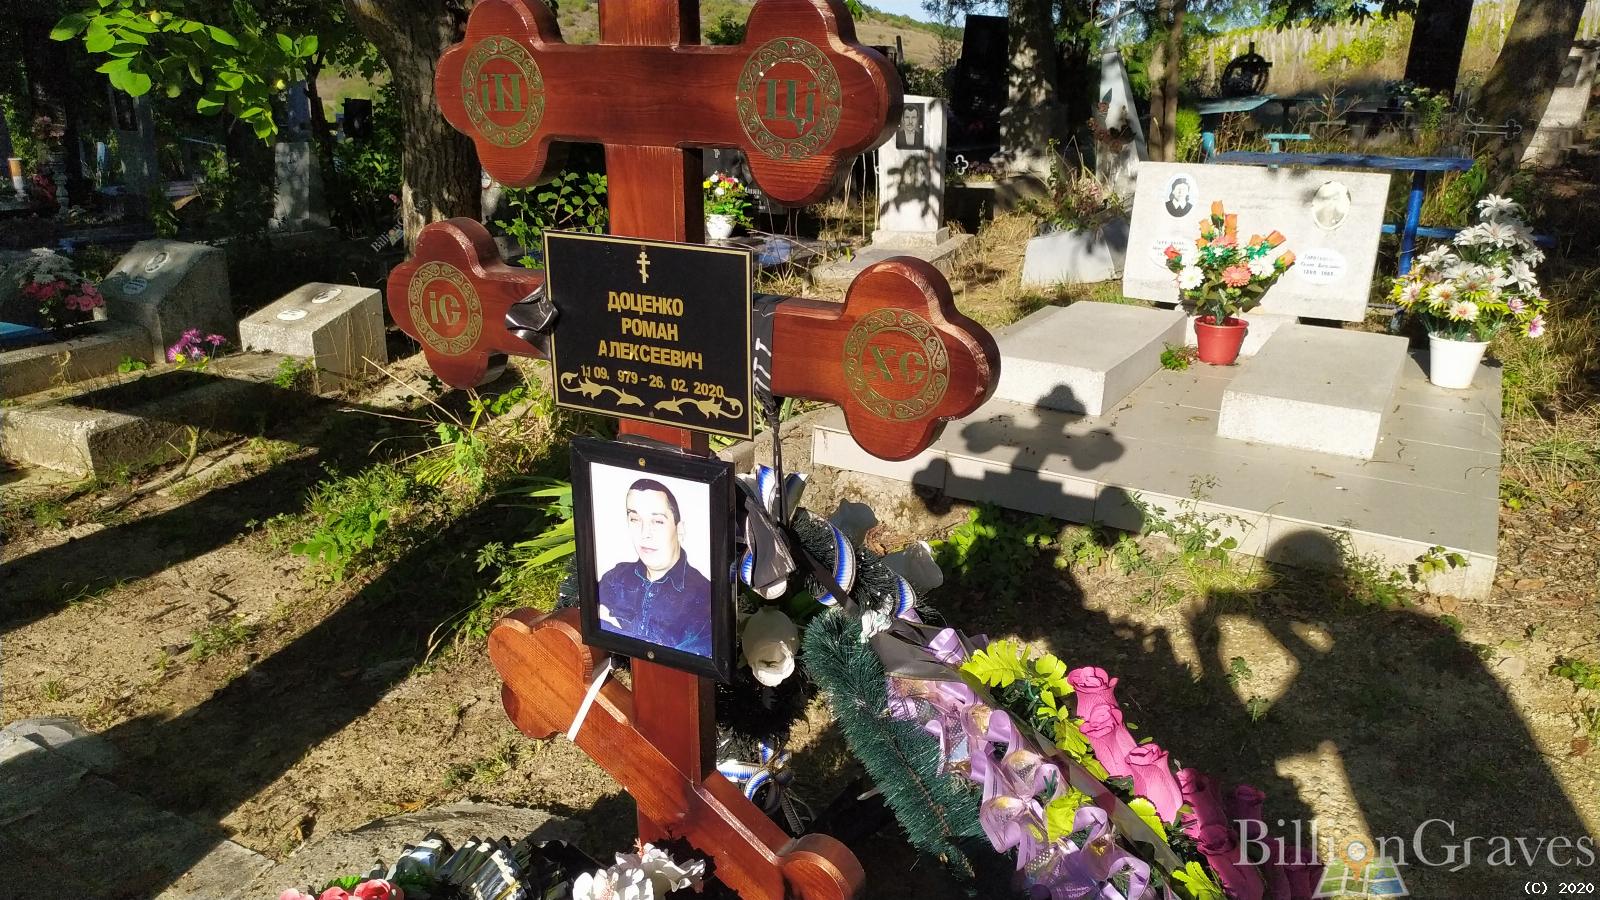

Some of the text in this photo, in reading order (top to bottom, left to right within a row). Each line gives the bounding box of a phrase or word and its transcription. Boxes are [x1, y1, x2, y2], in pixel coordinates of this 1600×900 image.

[607, 291, 684, 317] ДОЦЕНКО
[621, 318, 679, 342] РОМАН
[597, 340, 703, 370] АЛЕКСЕЕВИЧ
[693, 381, 724, 398] 2020
